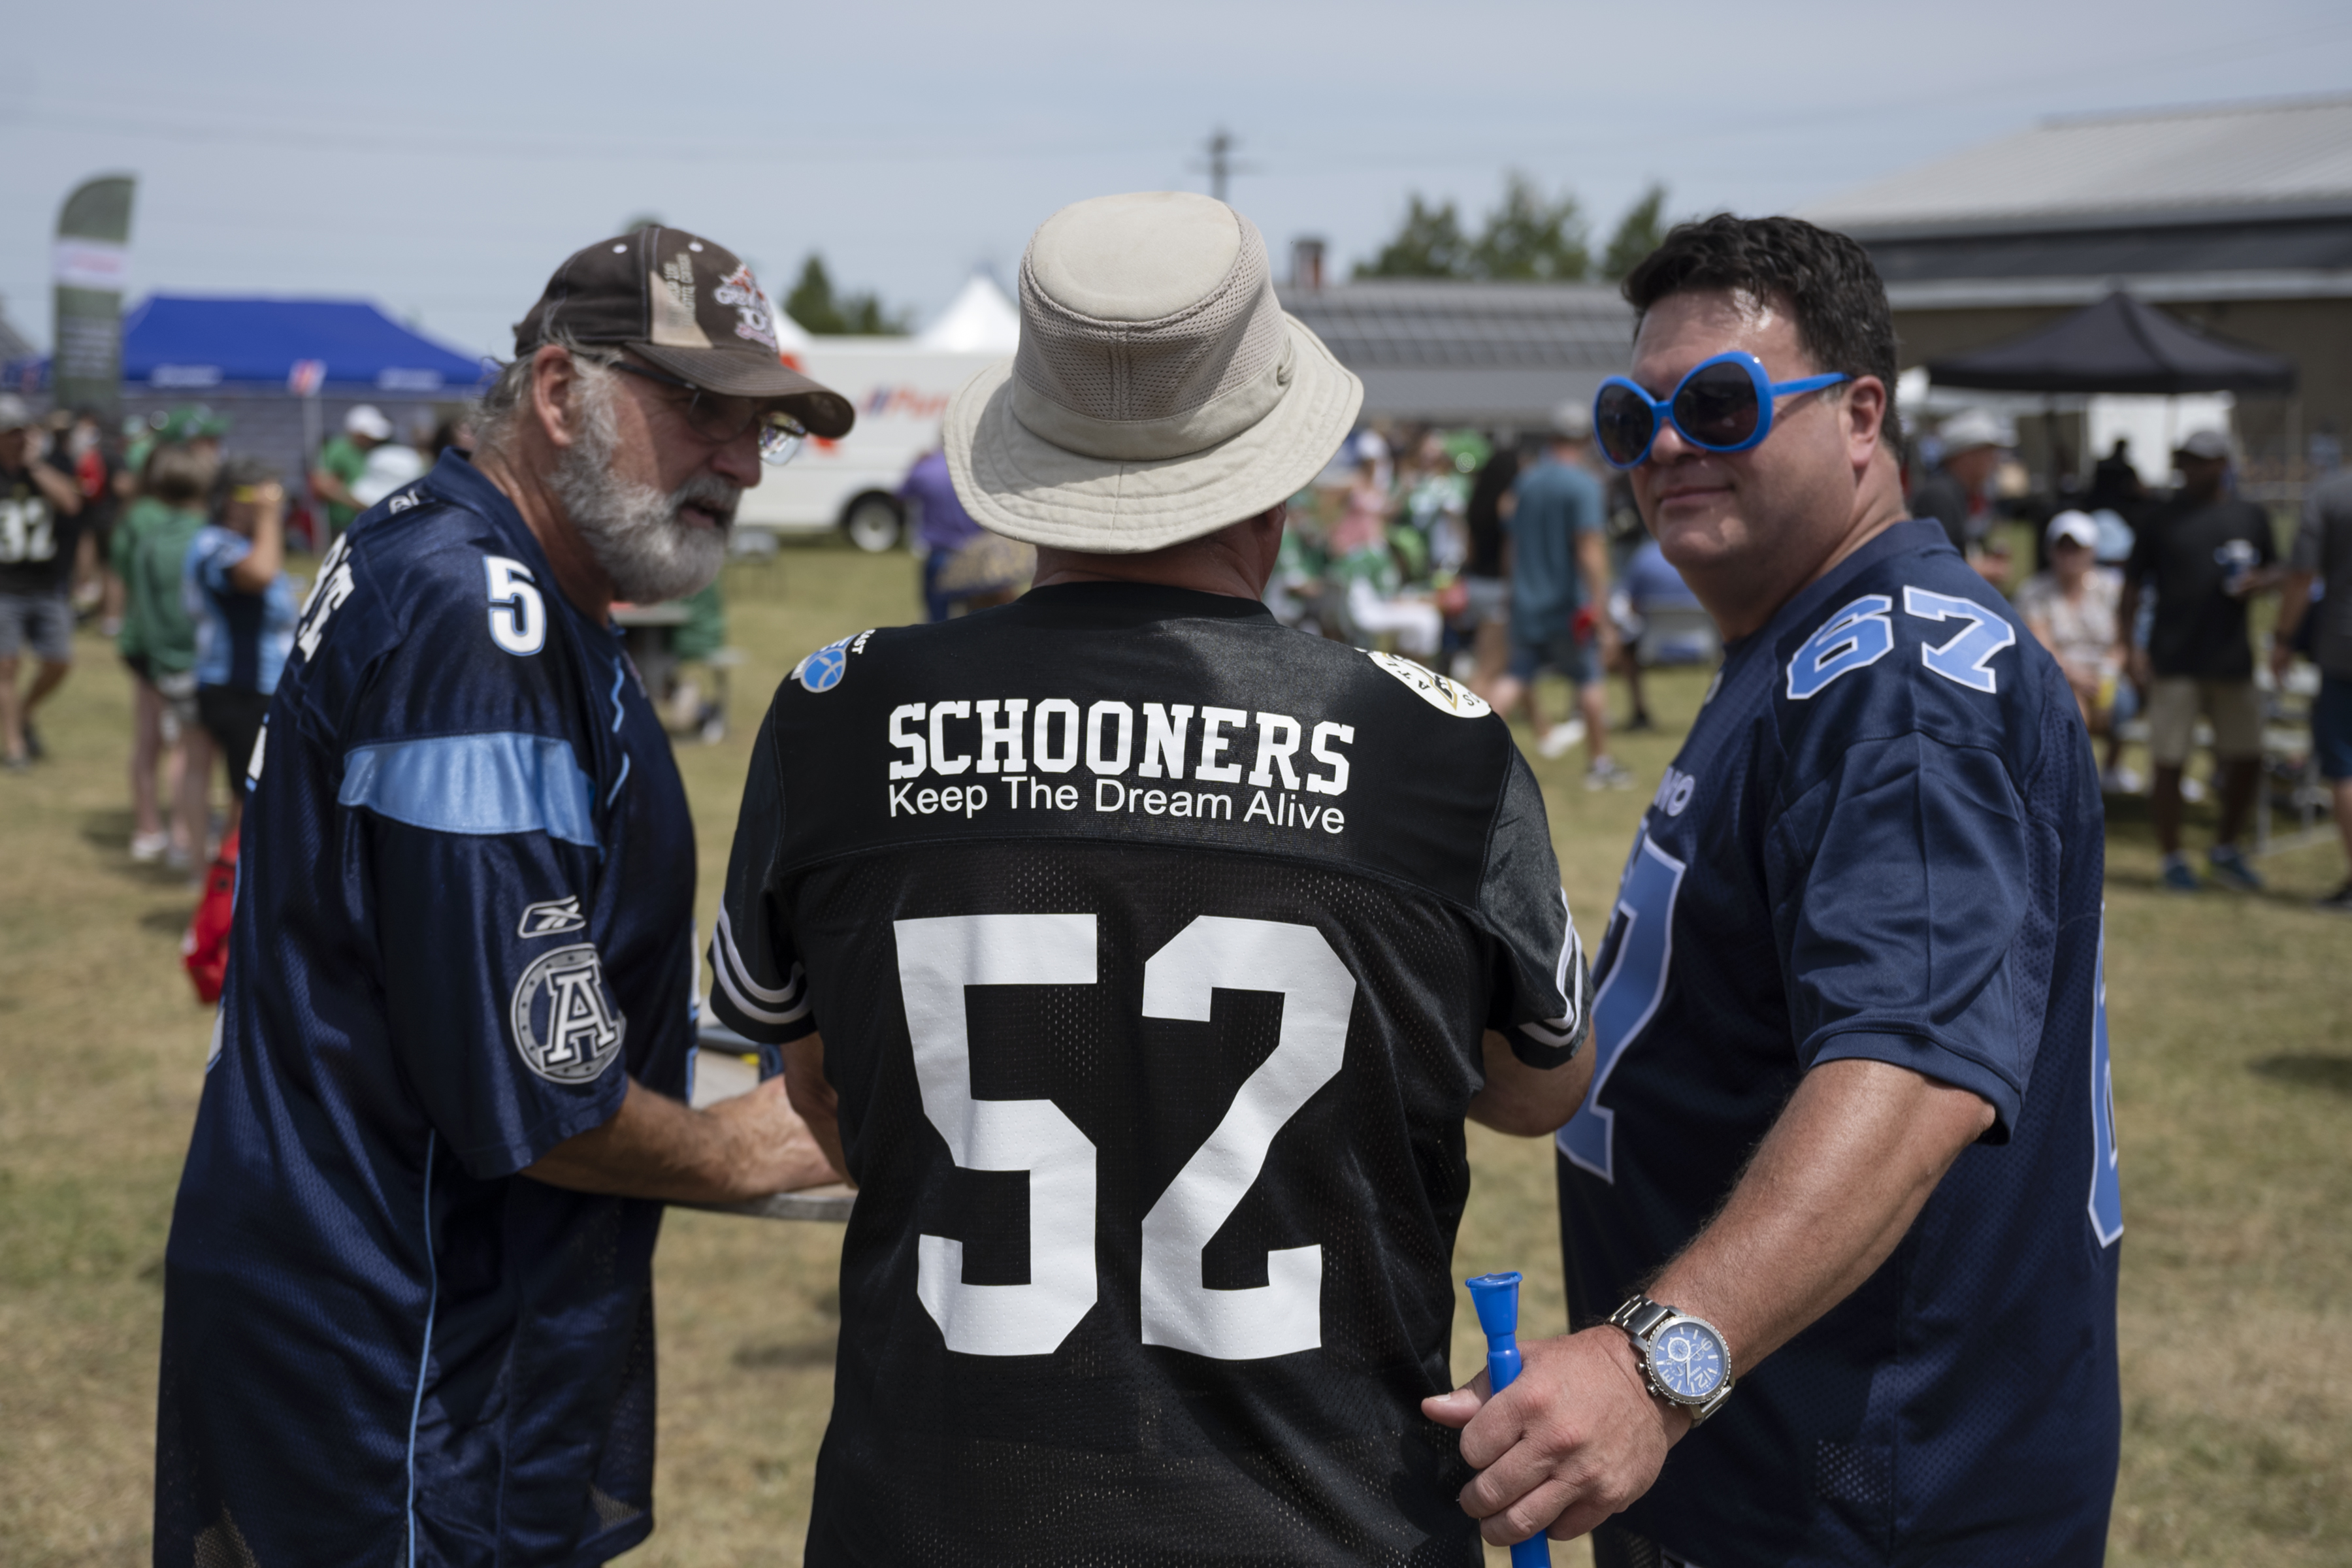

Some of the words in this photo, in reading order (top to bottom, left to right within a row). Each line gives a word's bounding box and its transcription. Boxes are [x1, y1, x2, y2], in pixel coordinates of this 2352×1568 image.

[482, 554, 547, 657] 5
[851, 629, 876, 654] EAST
[1786, 584, 2016, 700] 67
[889, 698, 1354, 796] SCHOONERS
[889, 781, 987, 818] Keep
[1002, 776, 1079, 810] The
[1096, 779, 1232, 819] Dream
[1243, 790, 1345, 834] Alive
[538, 958, 621, 1072] A
[1557, 823, 1687, 1184] 7
[893, 914, 1356, 1360] 52
